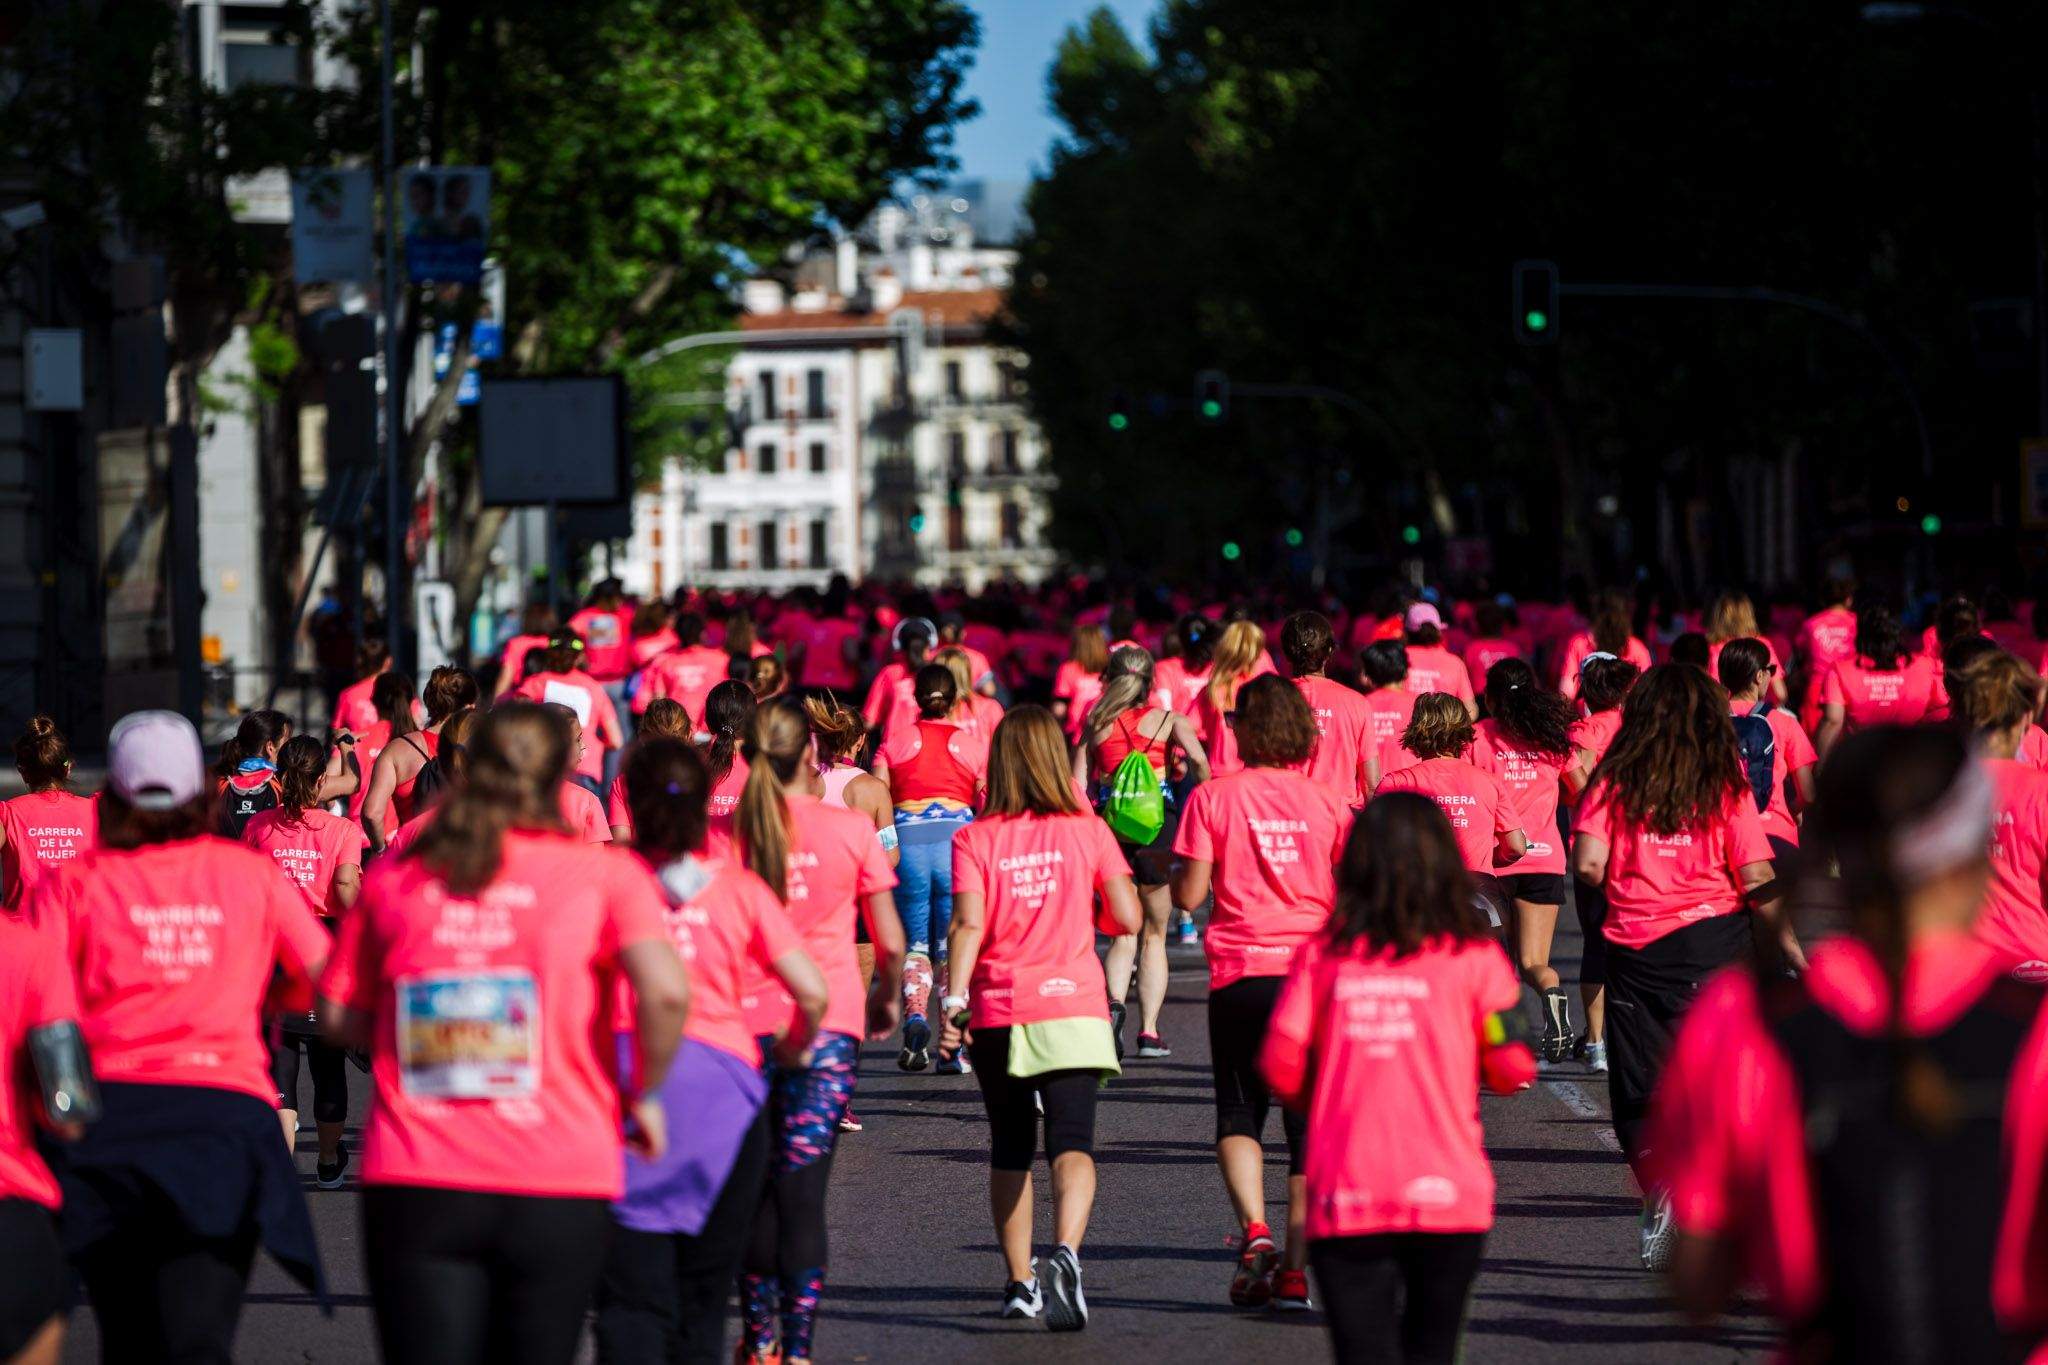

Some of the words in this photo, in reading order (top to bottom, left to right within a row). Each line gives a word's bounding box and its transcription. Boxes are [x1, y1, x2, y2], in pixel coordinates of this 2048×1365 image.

[1504, 771, 1538, 780] MUJER
[1436, 796, 1476, 805] RRERA
[28, 827, 83, 837] CARRERA
[40, 838, 55, 848] DE
[59, 838, 74, 848] LA
[1276, 834, 1296, 848] LA
[36, 849, 77, 859] MUJER
[273, 848, 323, 860] CARRERA
[282, 859, 298, 869] DE
[299, 861, 313, 871] LA
[999, 849, 1064, 872] CARRERA
[1012, 868, 1034, 884] DE
[1035, 864, 1053, 881] LA
[1010, 879, 1058, 899] MUJER
